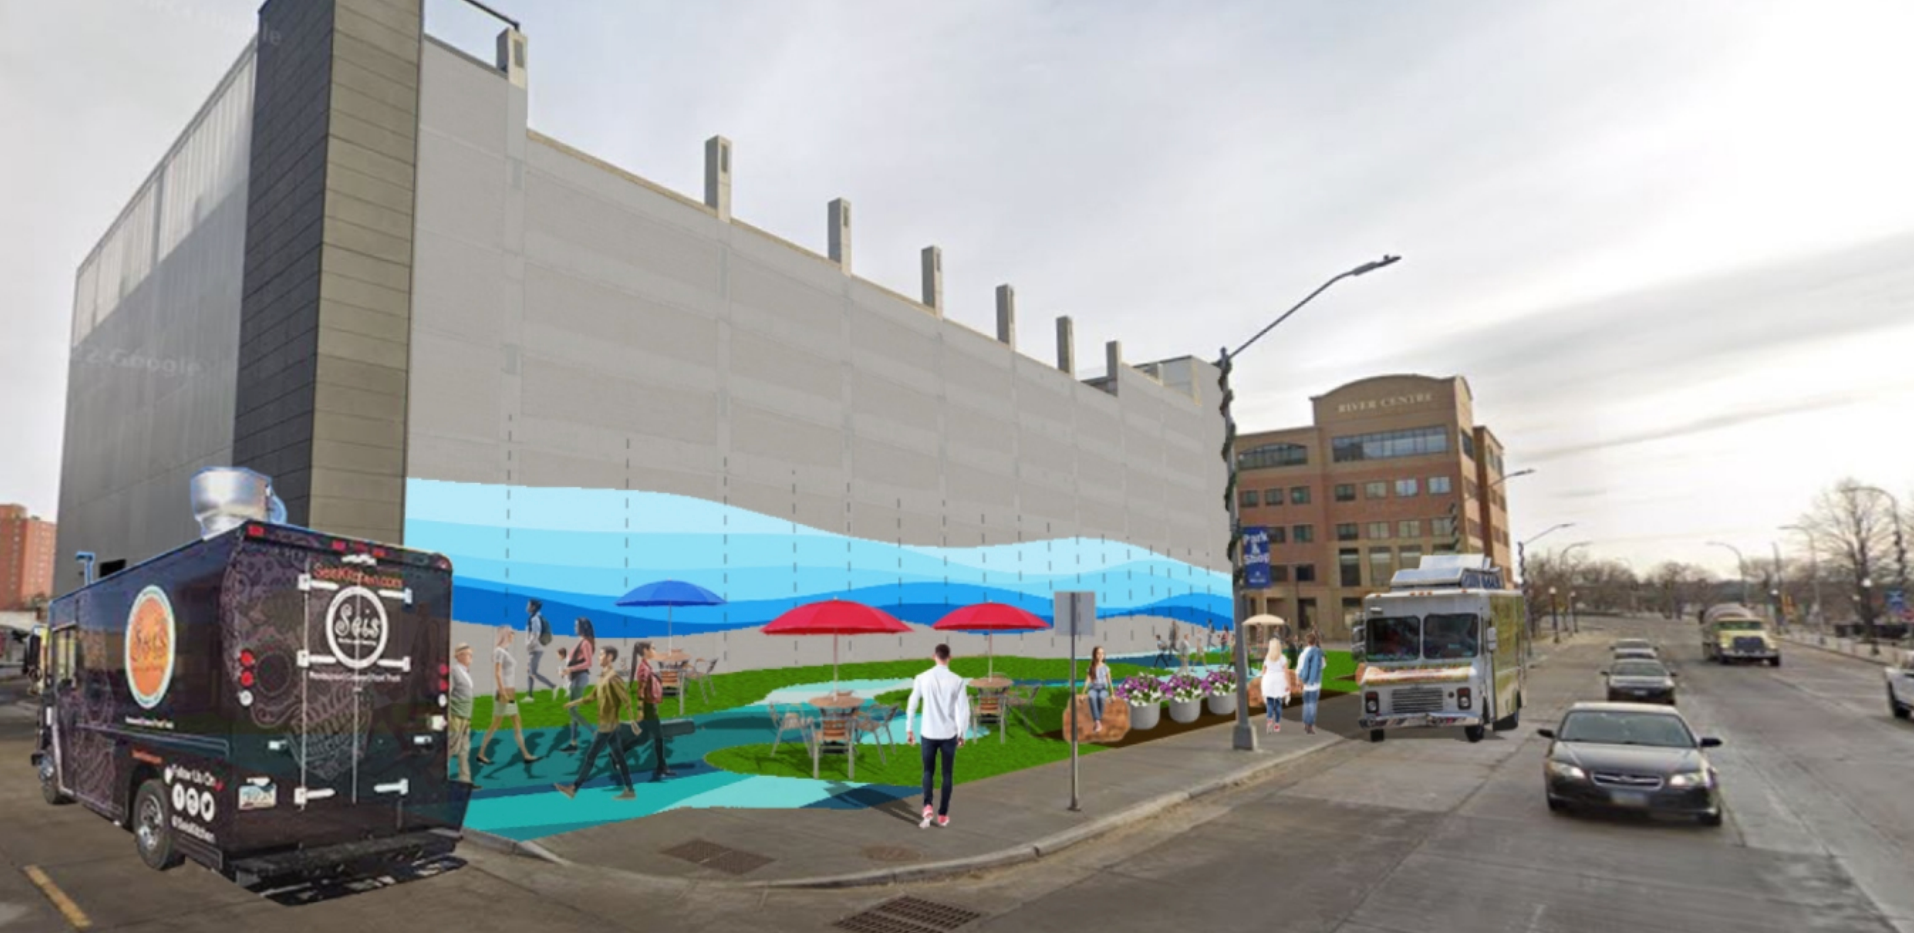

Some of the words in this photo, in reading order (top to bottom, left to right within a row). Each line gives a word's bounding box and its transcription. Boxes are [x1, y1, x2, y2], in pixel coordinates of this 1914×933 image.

[1338, 399, 1377, 413] RIVER
[1380, 392, 1432, 408] CENTRE
[1243, 530, 1268, 546] Park
[335, 603, 380, 638] Seis
